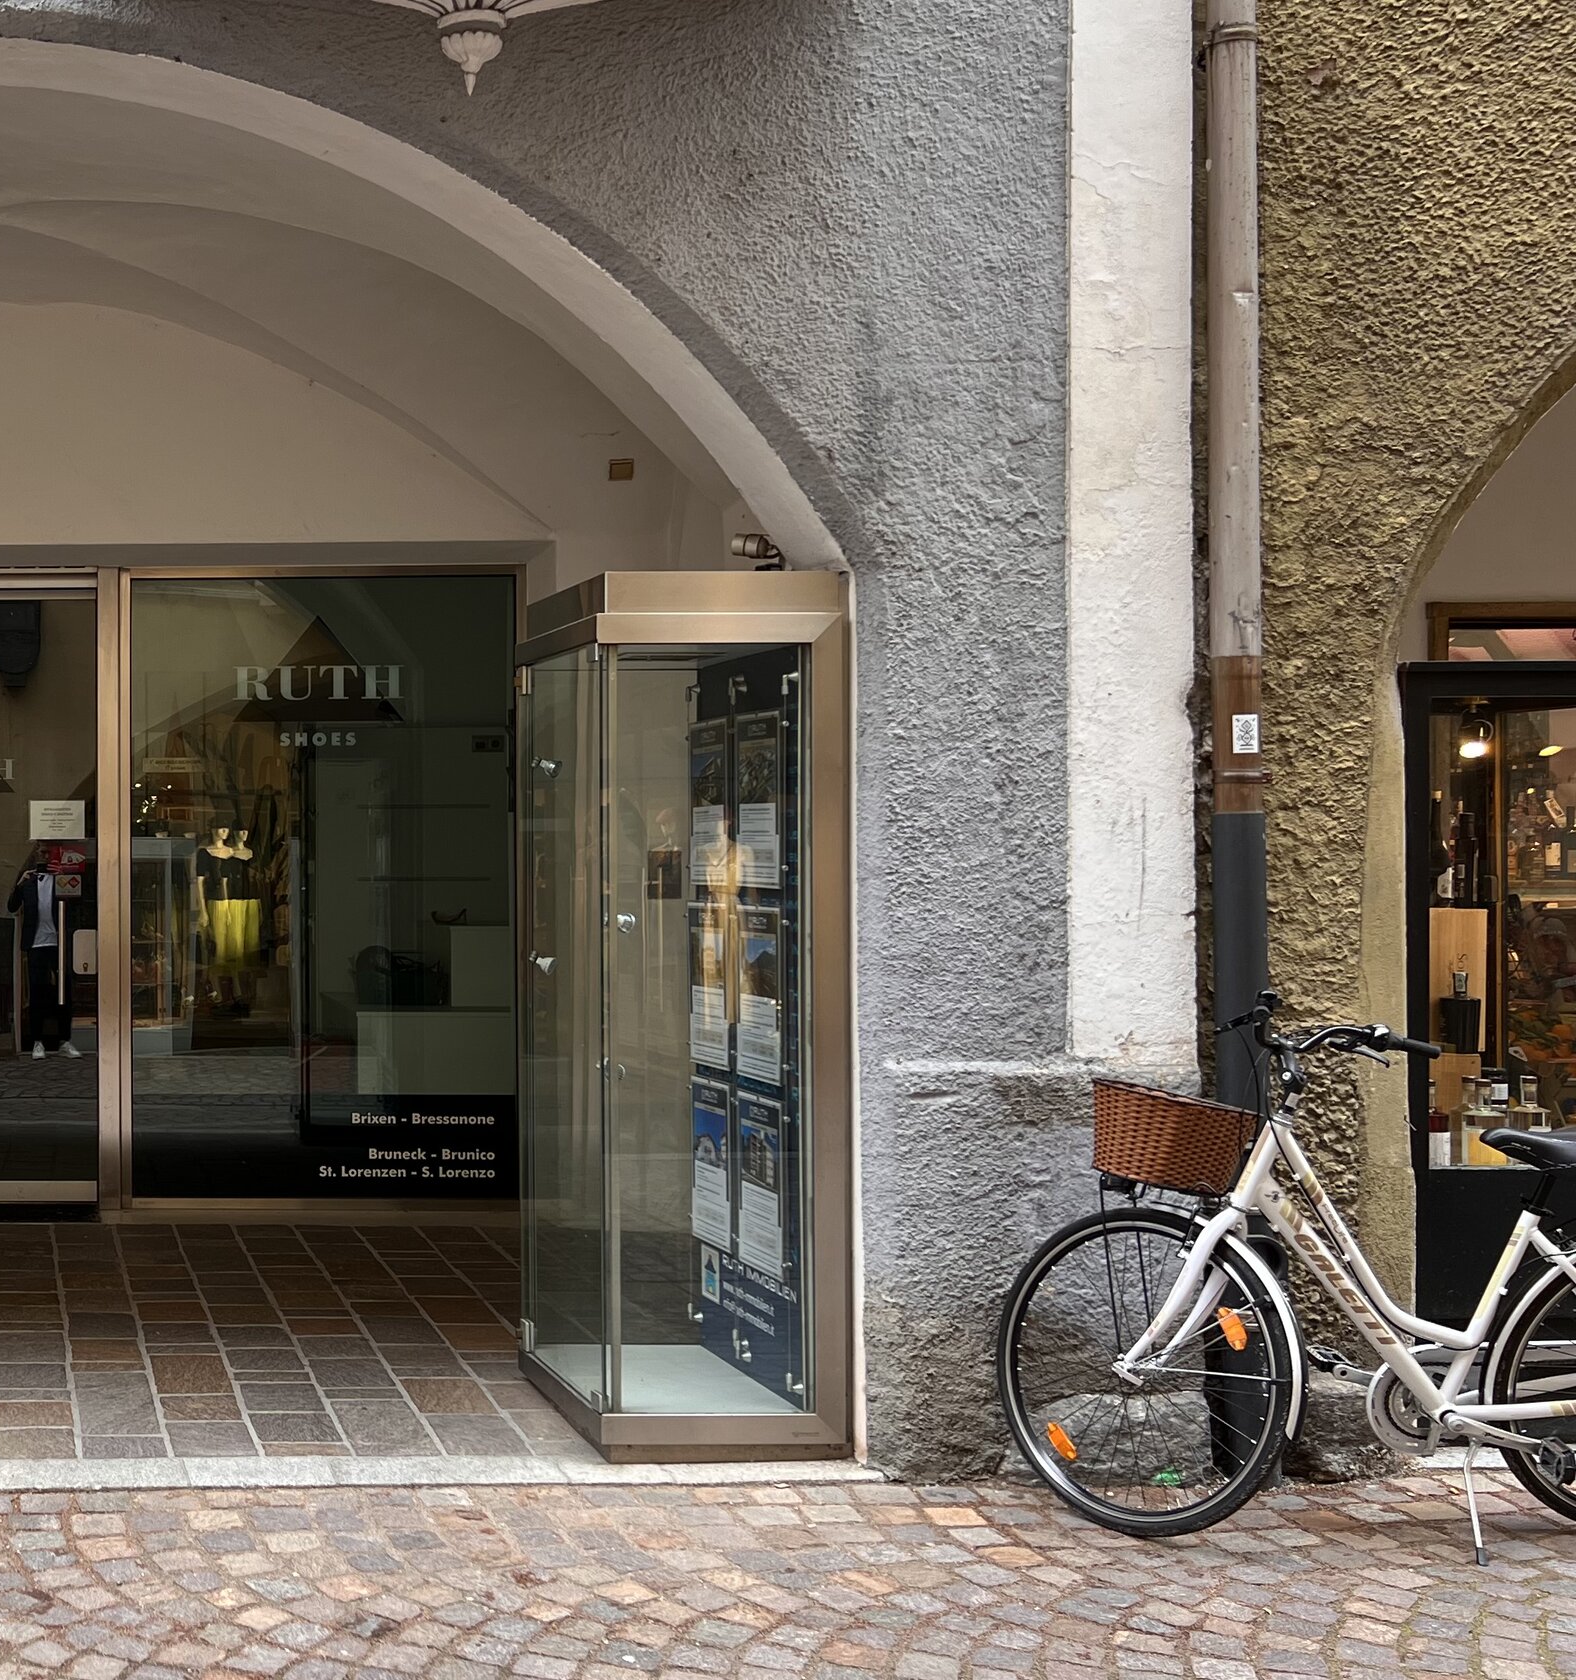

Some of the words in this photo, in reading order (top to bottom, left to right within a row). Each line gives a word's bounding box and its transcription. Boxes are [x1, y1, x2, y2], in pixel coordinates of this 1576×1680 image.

[232, 664, 404, 702] RUTH
[280, 732, 357, 747] SHOES
[351, 1112, 397, 1125] Brixen
[411, 1112, 495, 1125] Bressanone
[368, 1148, 427, 1160] Bruneck
[441, 1148, 496, 1160] Brunico
[318, 1165, 337, 1178] St.
[341, 1165, 407, 1178] Lorenzen
[421, 1166, 435, 1178] S.
[438, 1166, 496, 1178] Lorenzo
[1293, 1233, 1398, 1345] GALETTI
